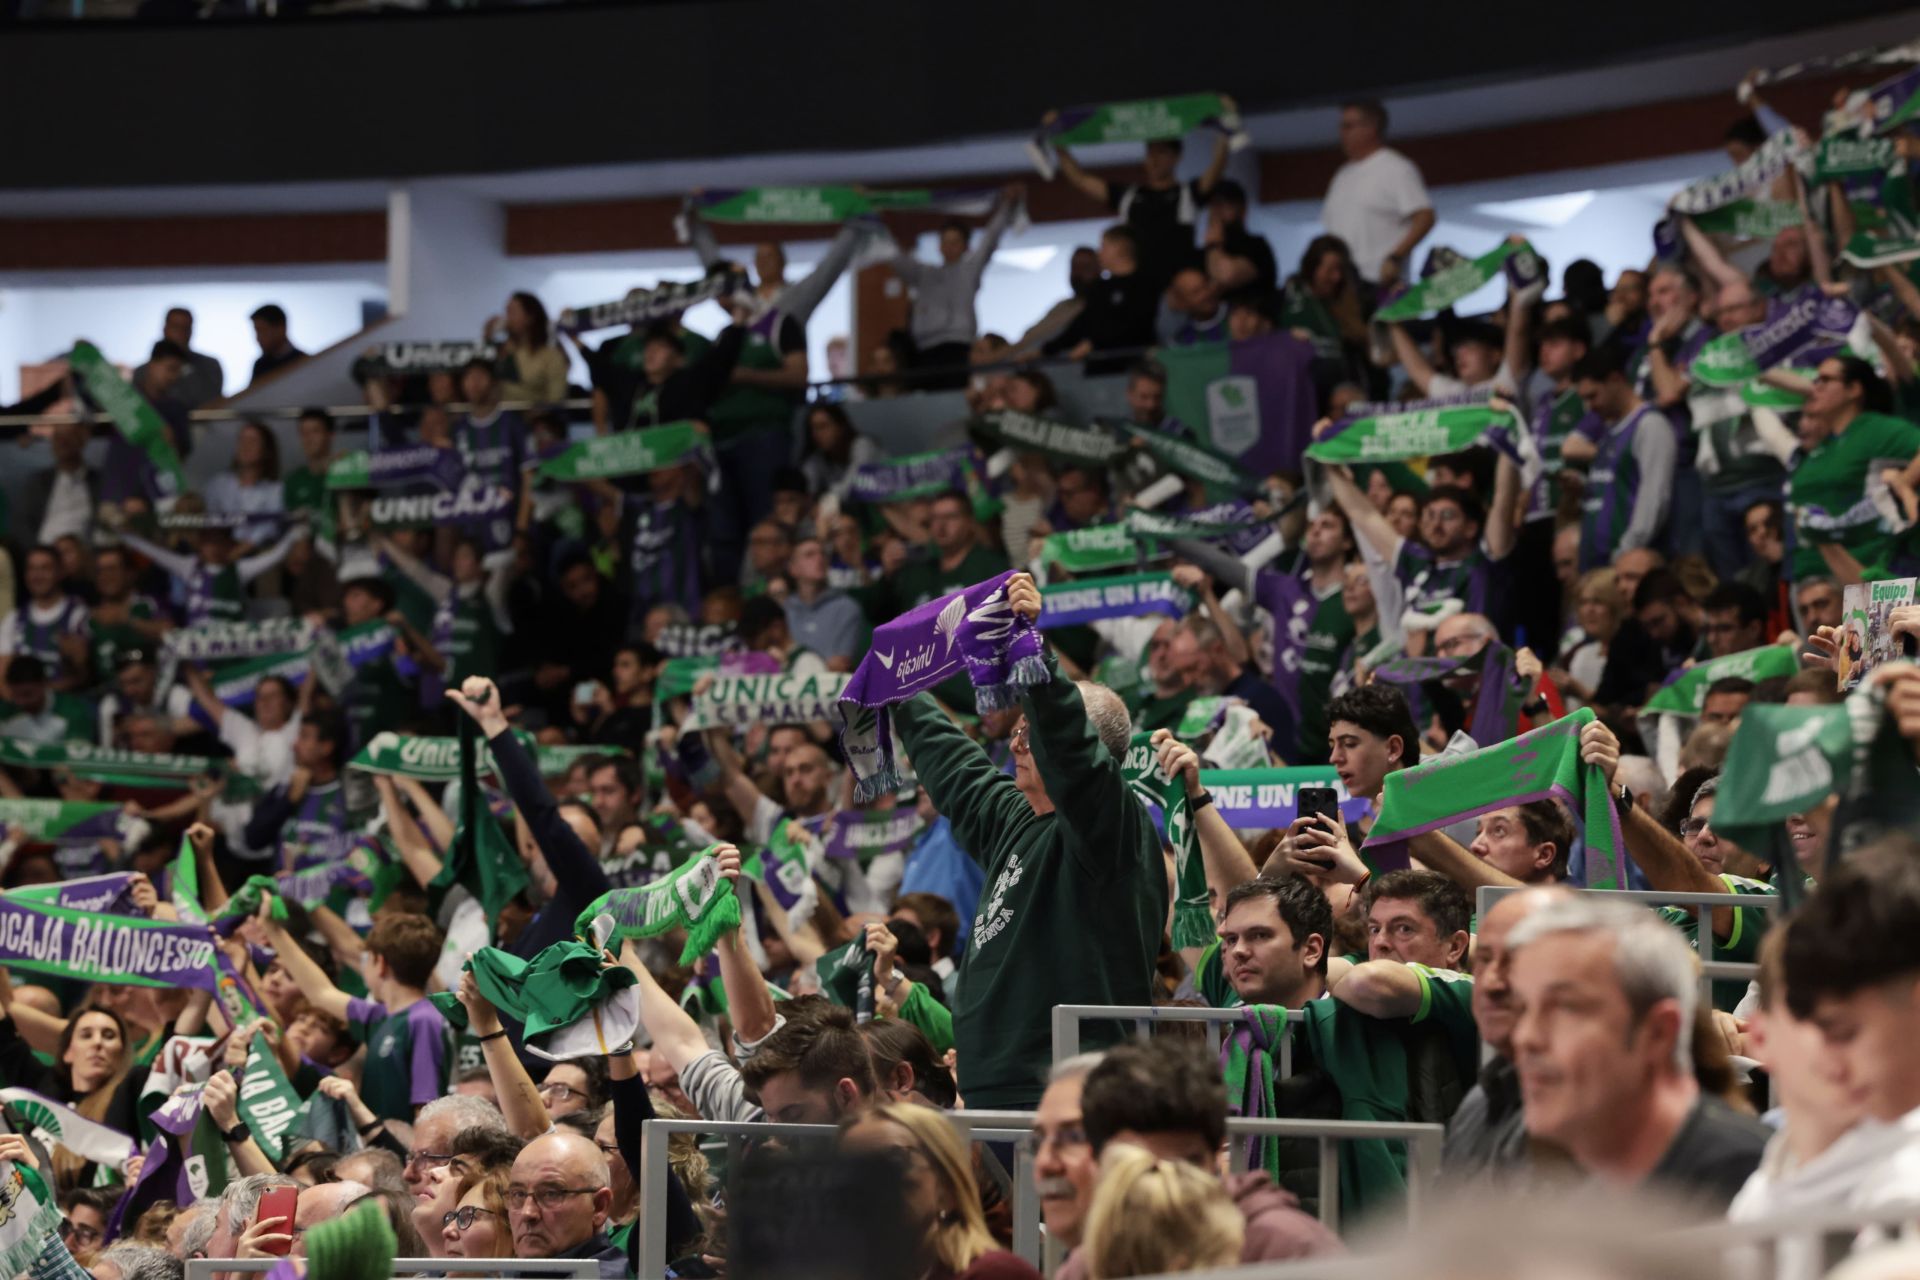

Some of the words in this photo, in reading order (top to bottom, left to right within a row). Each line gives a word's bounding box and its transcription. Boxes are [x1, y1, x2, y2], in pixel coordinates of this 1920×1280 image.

[370, 472, 498, 523] UNICAJ
[1044, 589, 1103, 614] TIENE
[1104, 582, 1136, 606] UN
[1872, 583, 1908, 602] Equipo
[710, 672, 846, 703] UNICAJ
[758, 699, 842, 723] MALAG
[1206, 785, 1252, 809] ENE
[1257, 783, 1294, 809] UN
[69, 916, 215, 976] BALONCESTO
